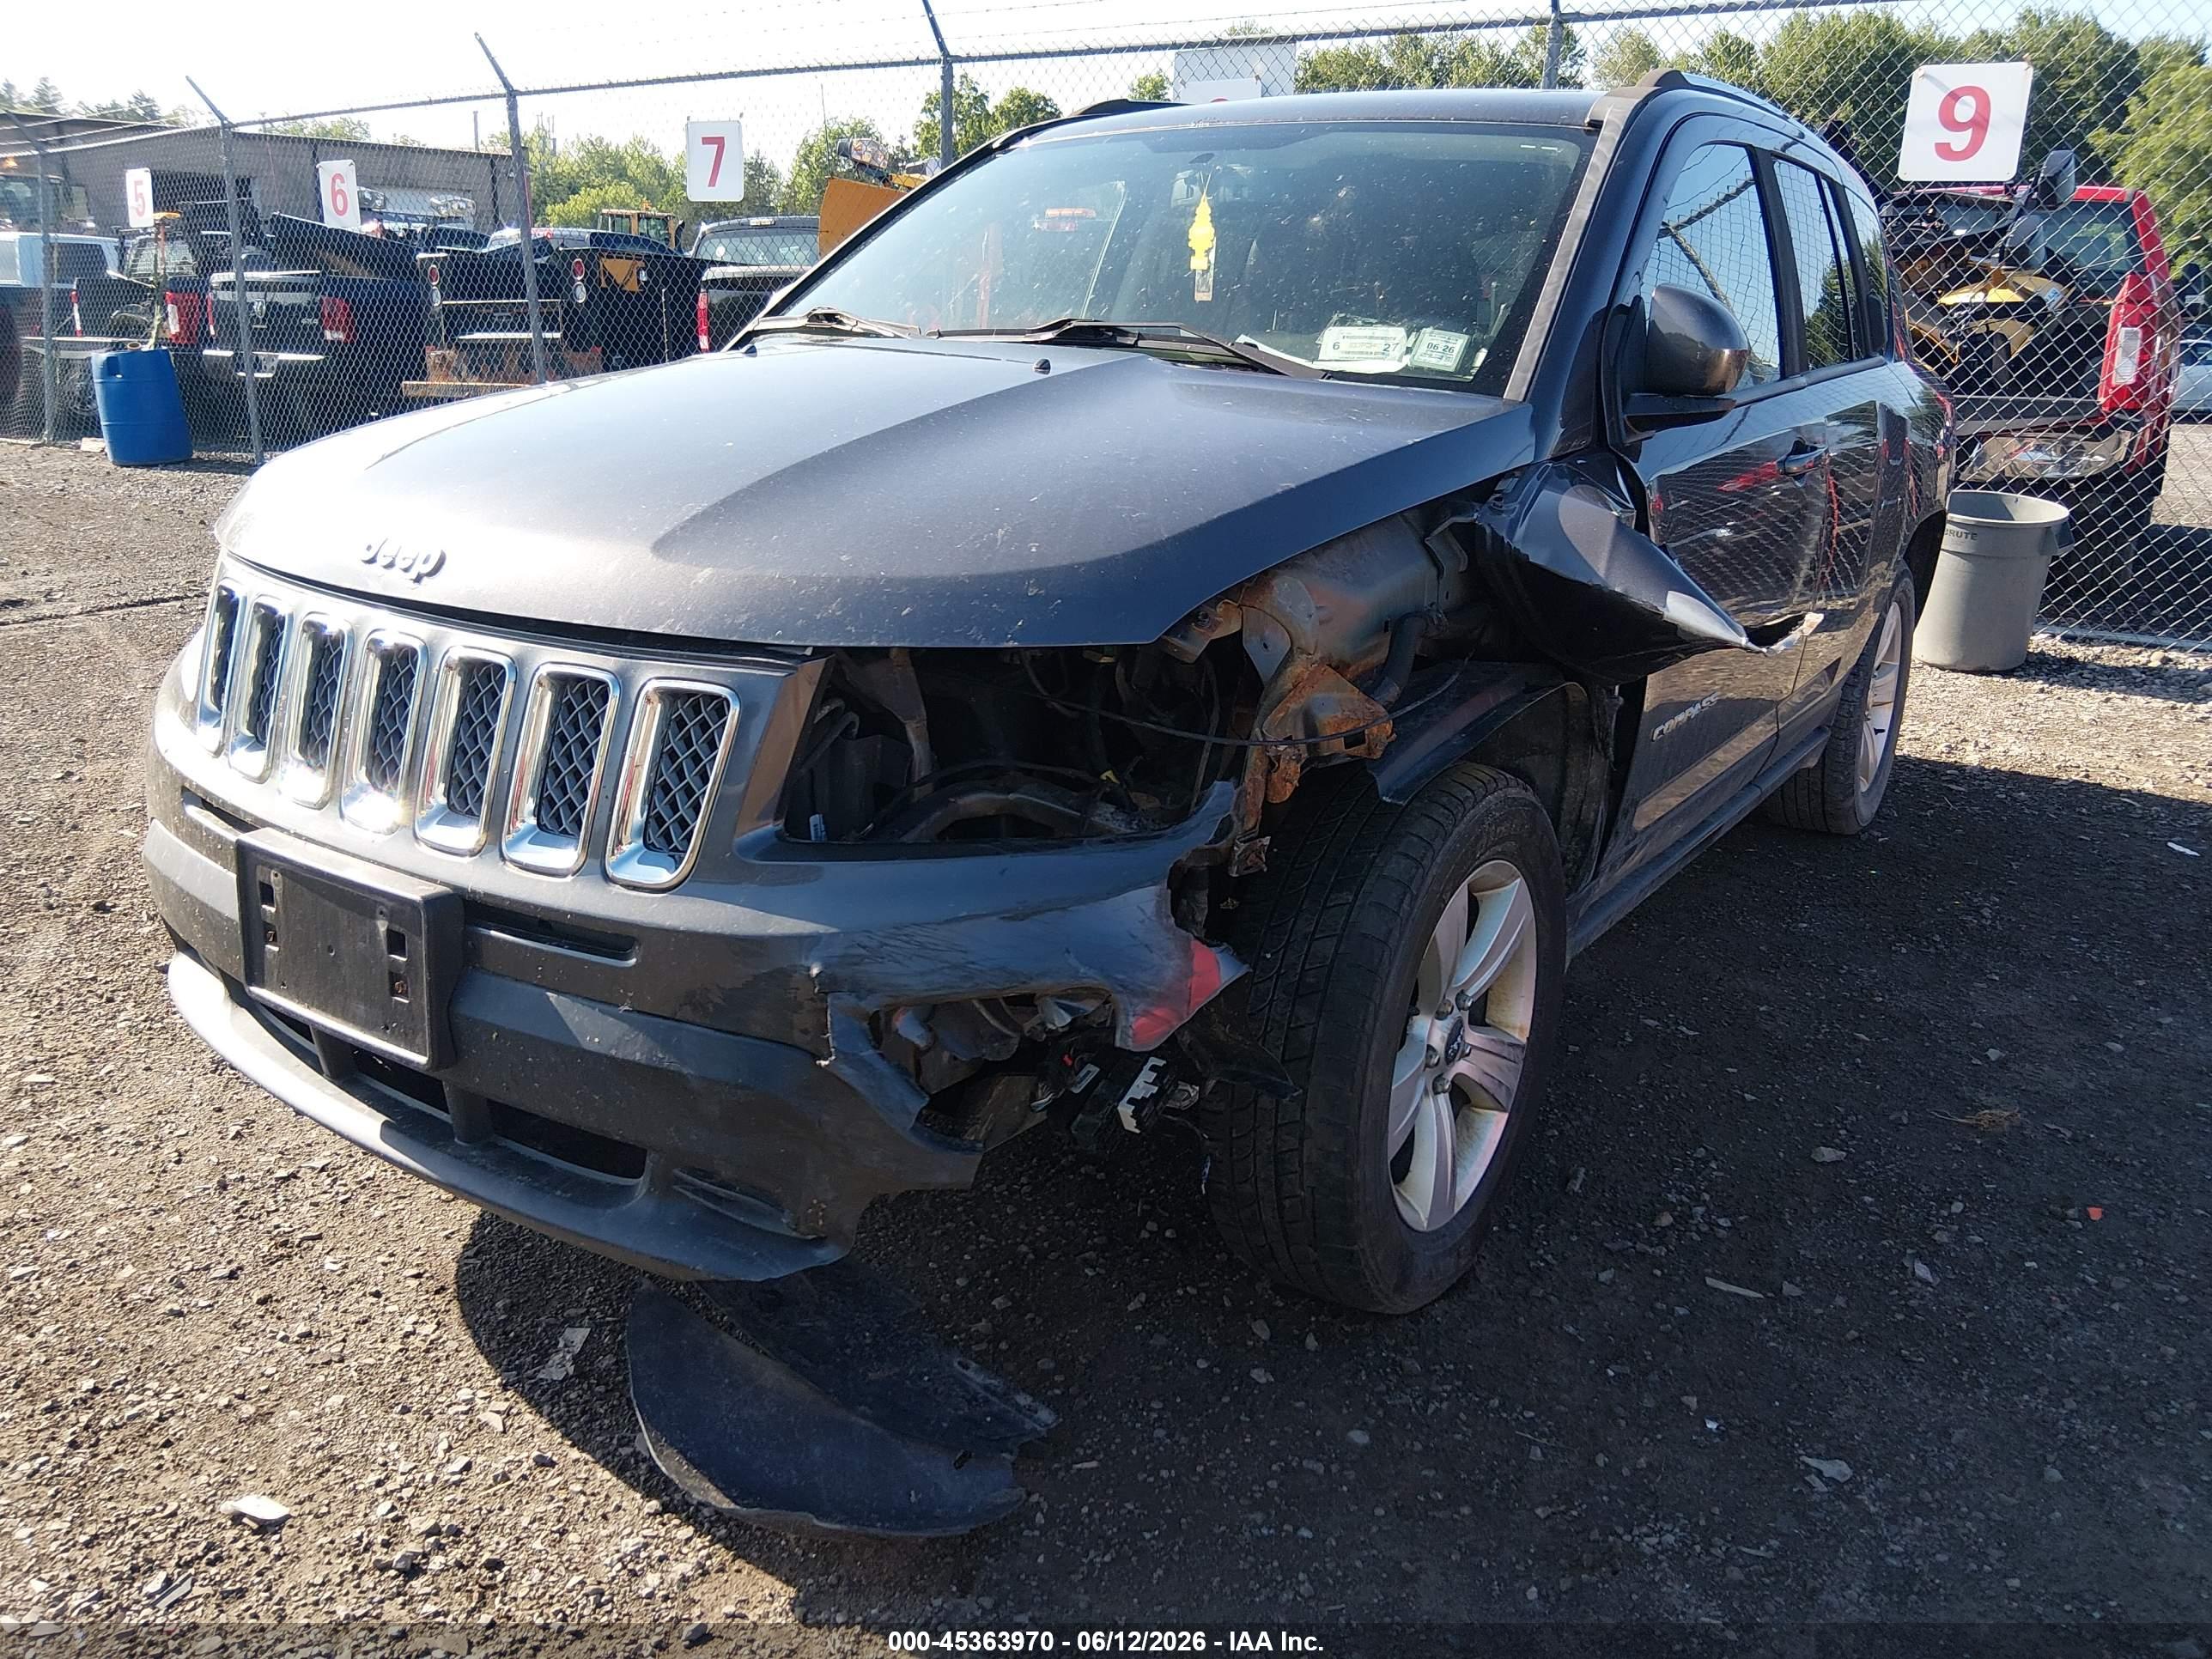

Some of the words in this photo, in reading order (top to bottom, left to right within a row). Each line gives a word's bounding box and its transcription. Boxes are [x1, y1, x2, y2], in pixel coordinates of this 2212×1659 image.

[1935, 85, 1991, 161] 9
[701, 136, 725, 187] 7
[132, 179, 146, 217] 5
[330, 173, 349, 217] 6
[359, 538, 447, 584] Jeep
